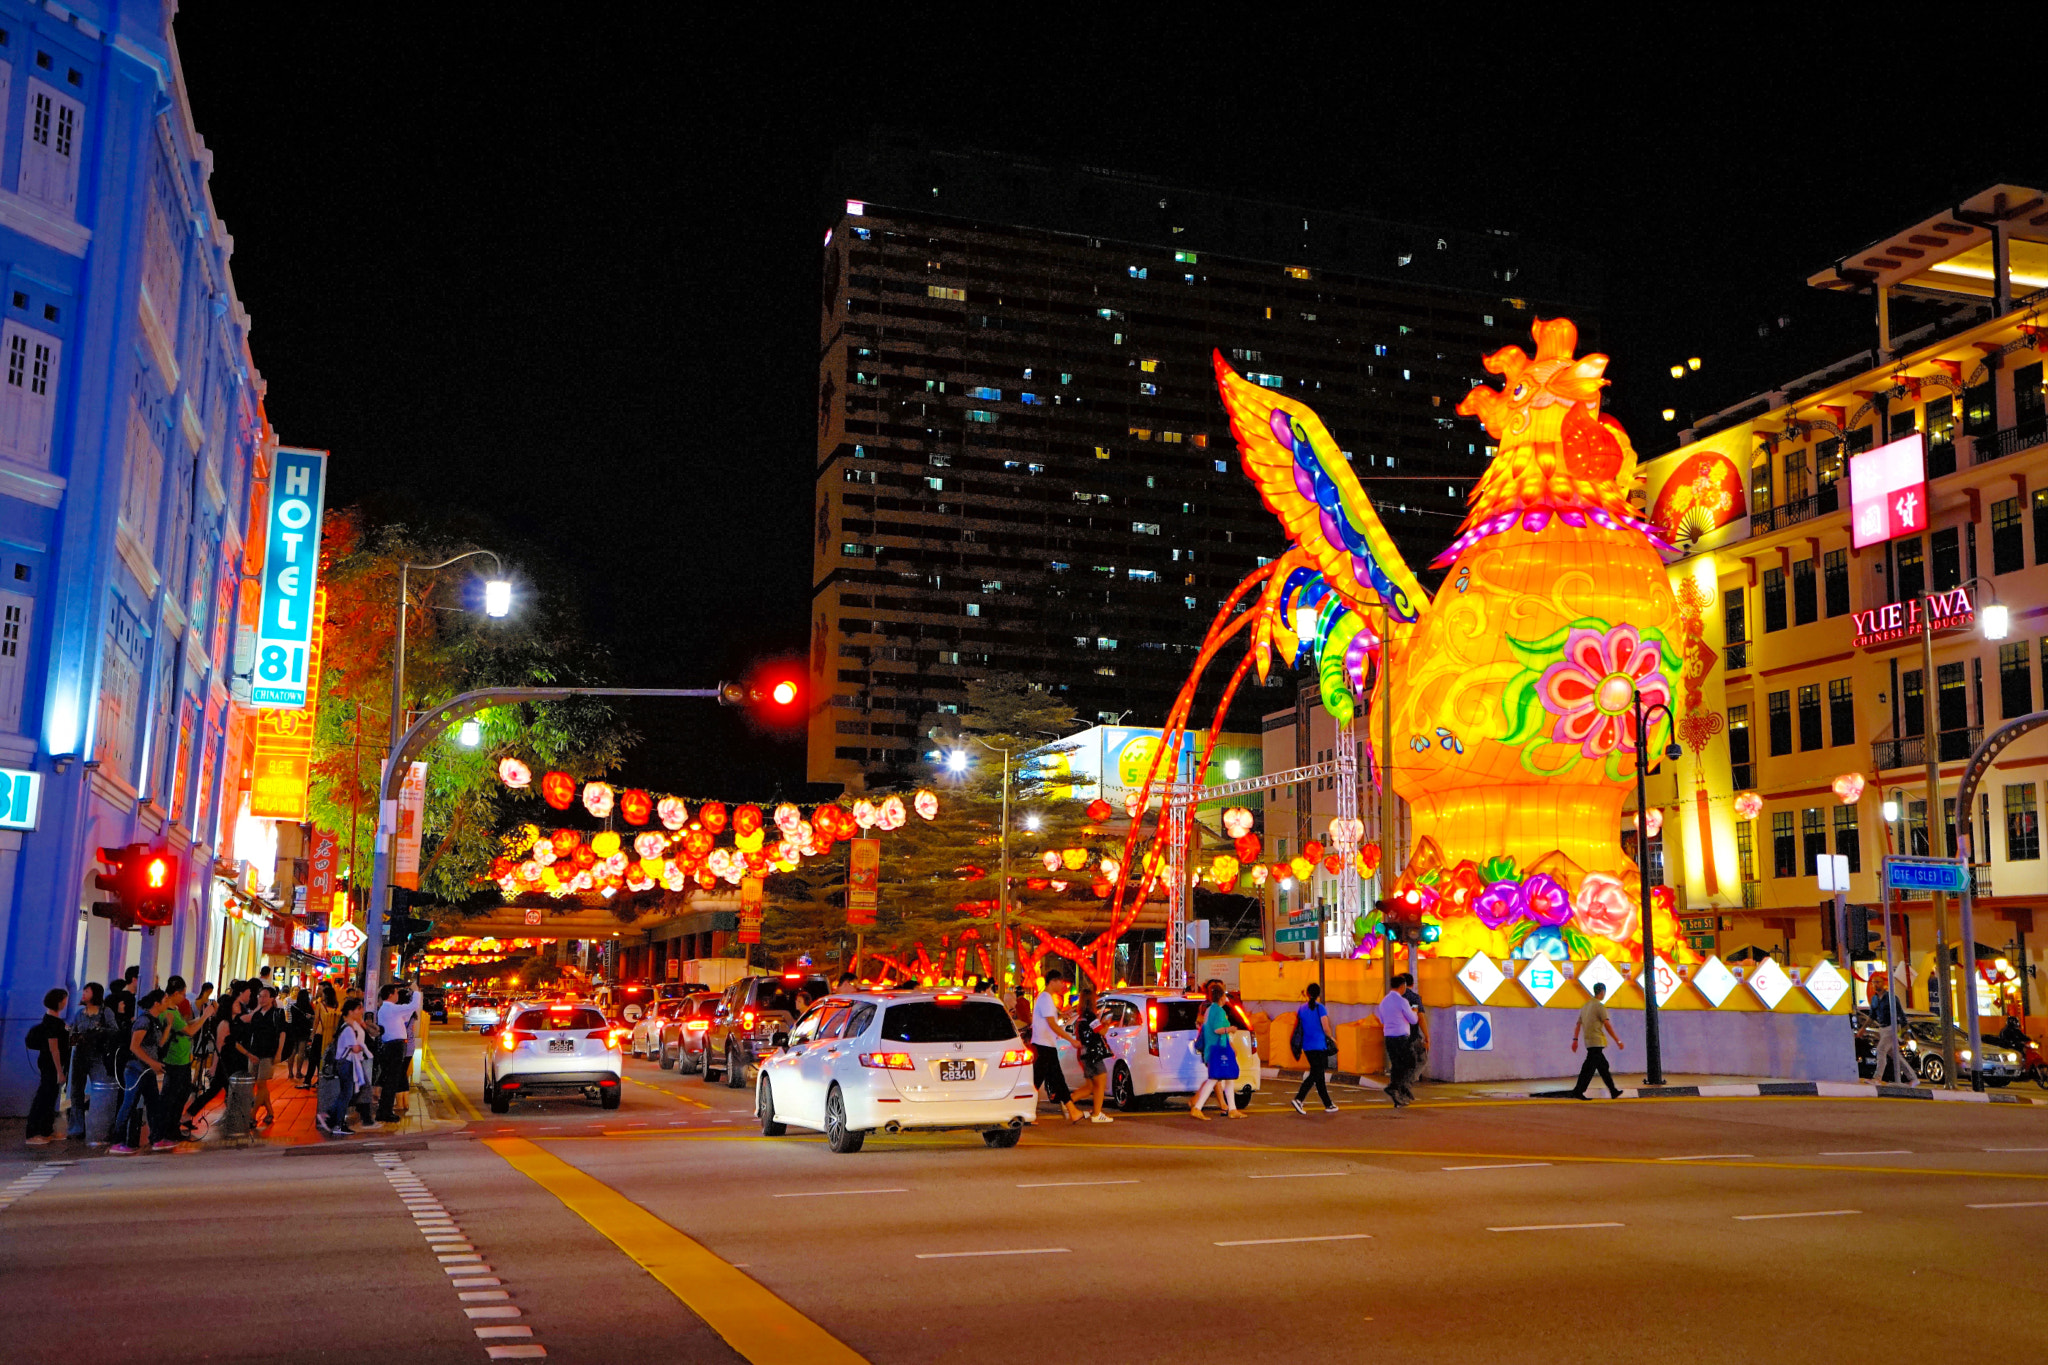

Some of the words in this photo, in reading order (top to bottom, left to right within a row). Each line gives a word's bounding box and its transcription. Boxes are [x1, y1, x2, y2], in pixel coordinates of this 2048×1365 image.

[277, 465, 312, 630] HOTEL
[1852, 602, 1902, 636] YUE
[1852, 627, 1904, 648] CHINESE
[1908, 613, 1974, 636] PRDUCTS
[258, 644, 304, 683] 81
[255, 689, 303, 703] CHINATOWN
[268, 760, 293, 775] BEE
[1127, 768, 1138, 783] 5
[255, 796, 299, 813] HIANG
[313, 838, 334, 895] 老四川
[1894, 869, 1910, 880] CTE
[1914, 869, 1937, 882] (SLE)
[1689, 919, 1702, 929] Sen
[1704, 918, 1713, 928] St
[947, 1062, 967, 1071] SJP
[942, 1070, 975, 1081] 2834U
